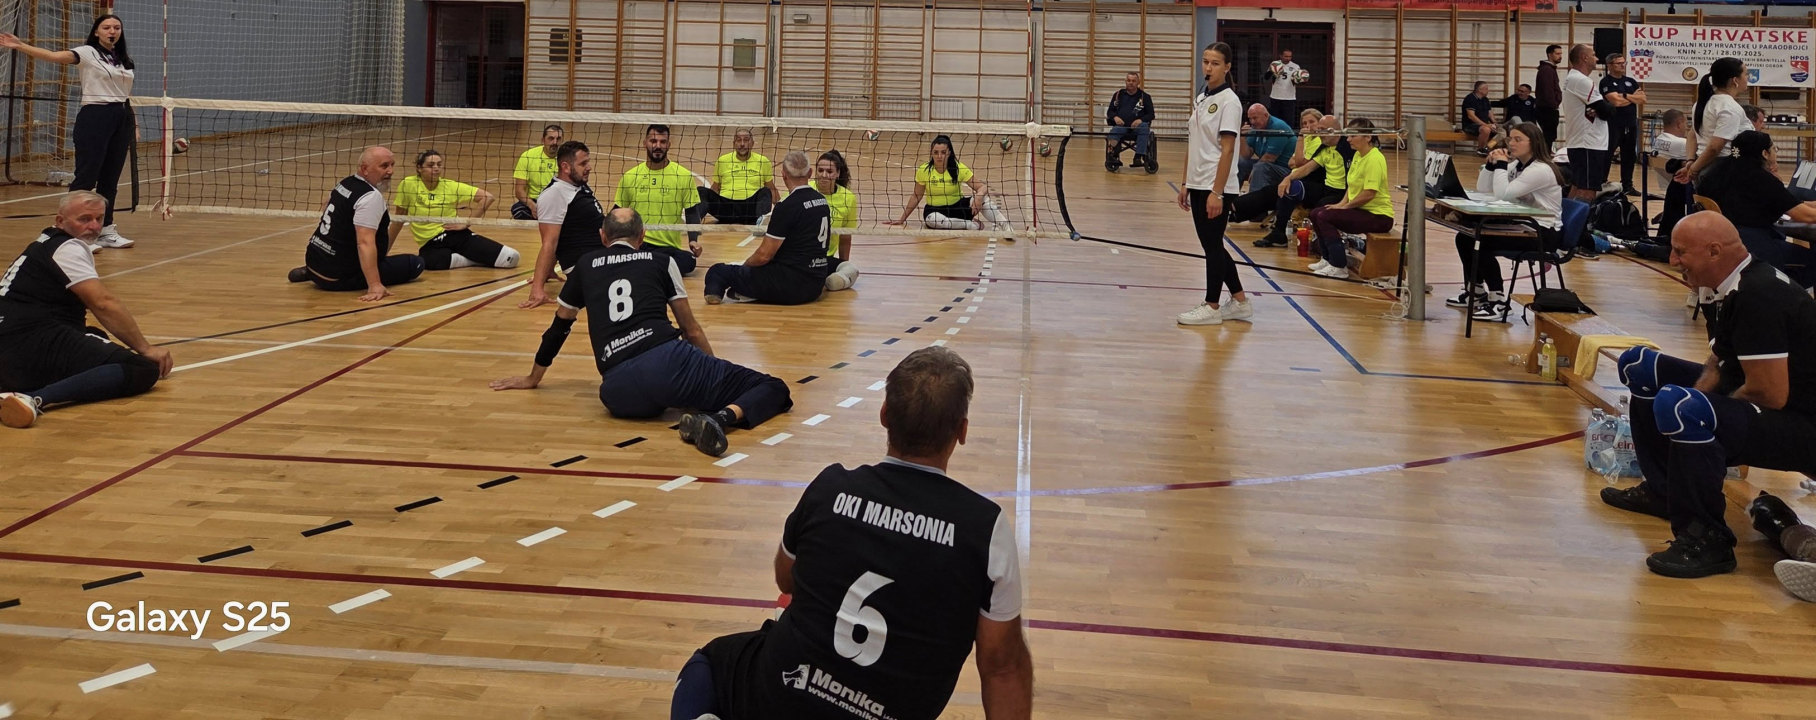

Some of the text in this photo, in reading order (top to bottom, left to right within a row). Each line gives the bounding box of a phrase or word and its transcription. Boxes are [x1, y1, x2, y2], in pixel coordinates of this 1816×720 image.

[1634, 27, 1807, 43] KUP HRVATSKE
[651, 178, 657, 186] 3
[319, 203, 335, 235] 5
[818, 216, 828, 249] 4
[592, 252, 653, 268] OKI MARSONIA
[608, 278, 634, 322] 8
[611, 327, 645, 349] Monika
[832, 492, 955, 547] OKI MARSONIA
[833, 570, 895, 667] 6
[811, 668, 885, 717] Monika
